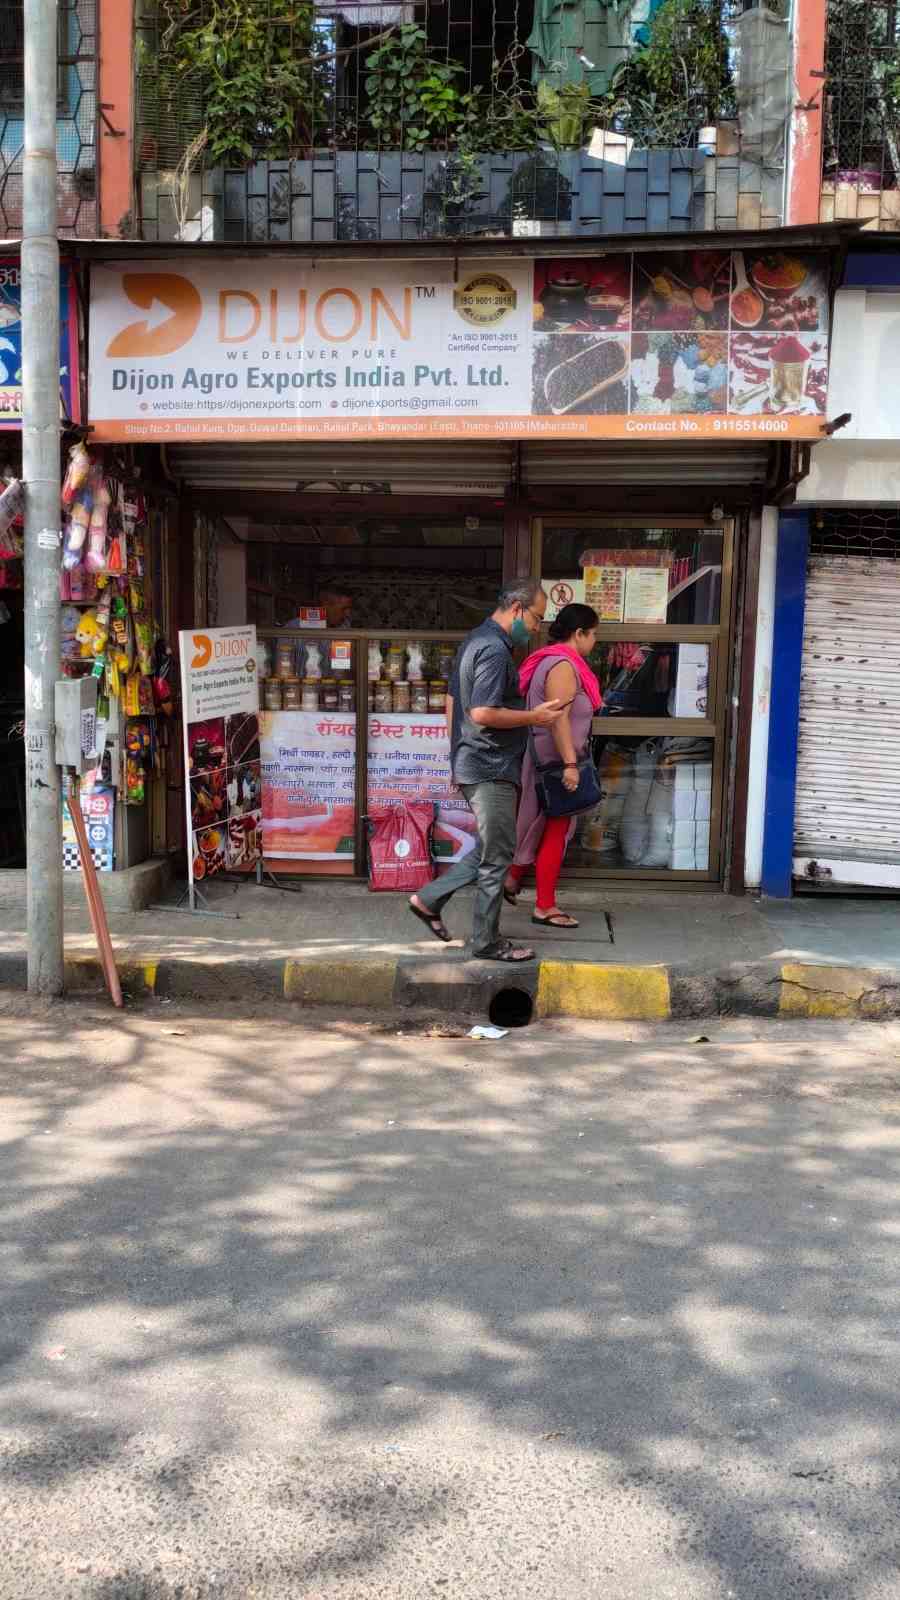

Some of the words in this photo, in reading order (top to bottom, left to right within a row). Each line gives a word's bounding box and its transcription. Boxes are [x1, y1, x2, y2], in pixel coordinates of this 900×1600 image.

[218, 287, 413, 344] DIJON
[416, 286, 436, 298] TM
[226, 351, 249, 360] WE
[262, 350, 338, 360] DELIVER
[352, 349, 397, 359] PURE
[448, 343, 479, 352] Certified
[112, 368, 174, 395] Dijon
[182, 367, 238, 394] Agro
[247, 366, 337, 394] Exports
[345, 366, 405, 388] India
[414, 365, 458, 387] Pvt.
[467, 365, 509, 387] Ltd.
[342, 397, 478, 410] dijonexports@gmail.com
[626, 420, 676, 432] Contact
[680, 418, 701, 431] No.
[214, 638, 248, 658] DIJON
[369, 719, 405, 738] टेस्ट
[410, 726, 448, 739] मसा
